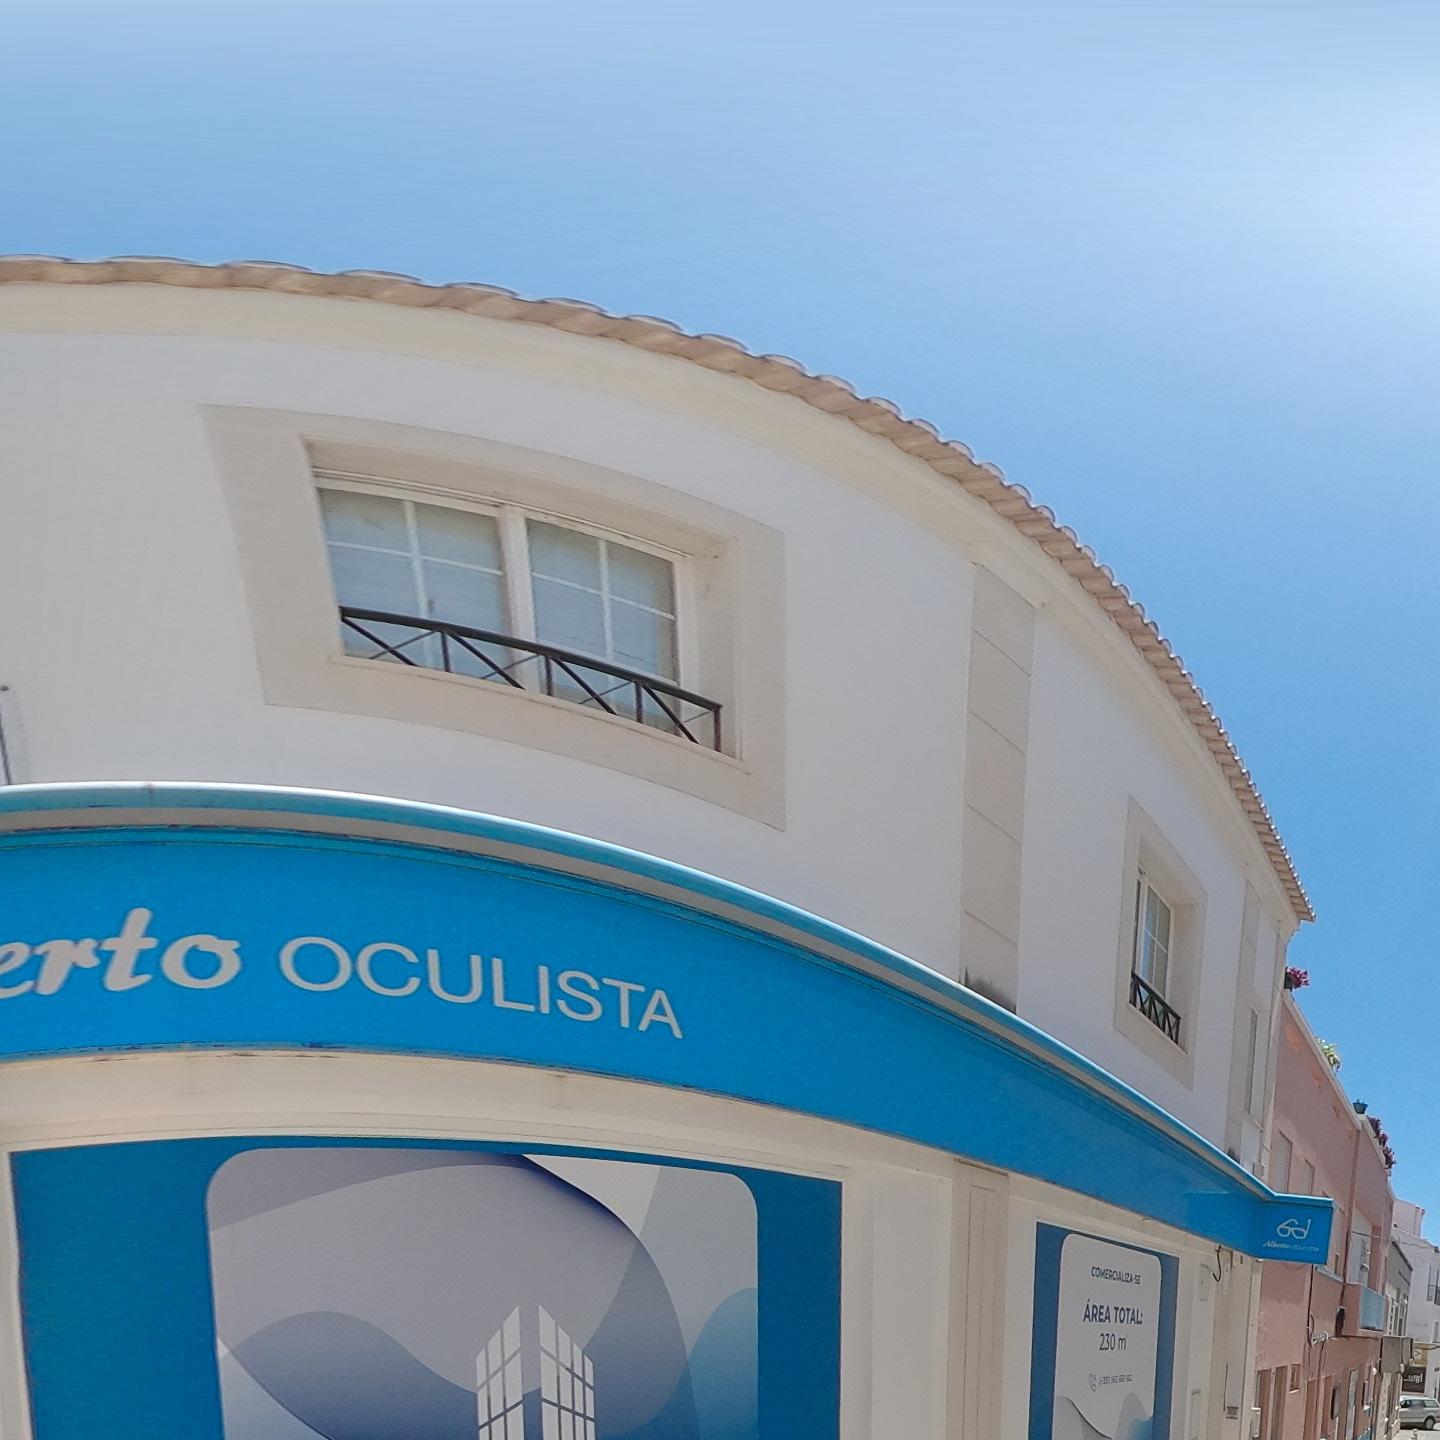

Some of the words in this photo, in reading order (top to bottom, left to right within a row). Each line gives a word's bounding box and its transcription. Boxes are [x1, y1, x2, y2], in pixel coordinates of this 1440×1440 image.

[278, 935, 684, 1040] OCULISTA
[1091, 1266, 1141, 1285] COMERCIALIZA-SE
[1083, 1299, 1111, 1323] ÁREA
[1114, 1306, 1143, 1325] TOTAL:
[1100, 1333, 1116, 1350] 230
